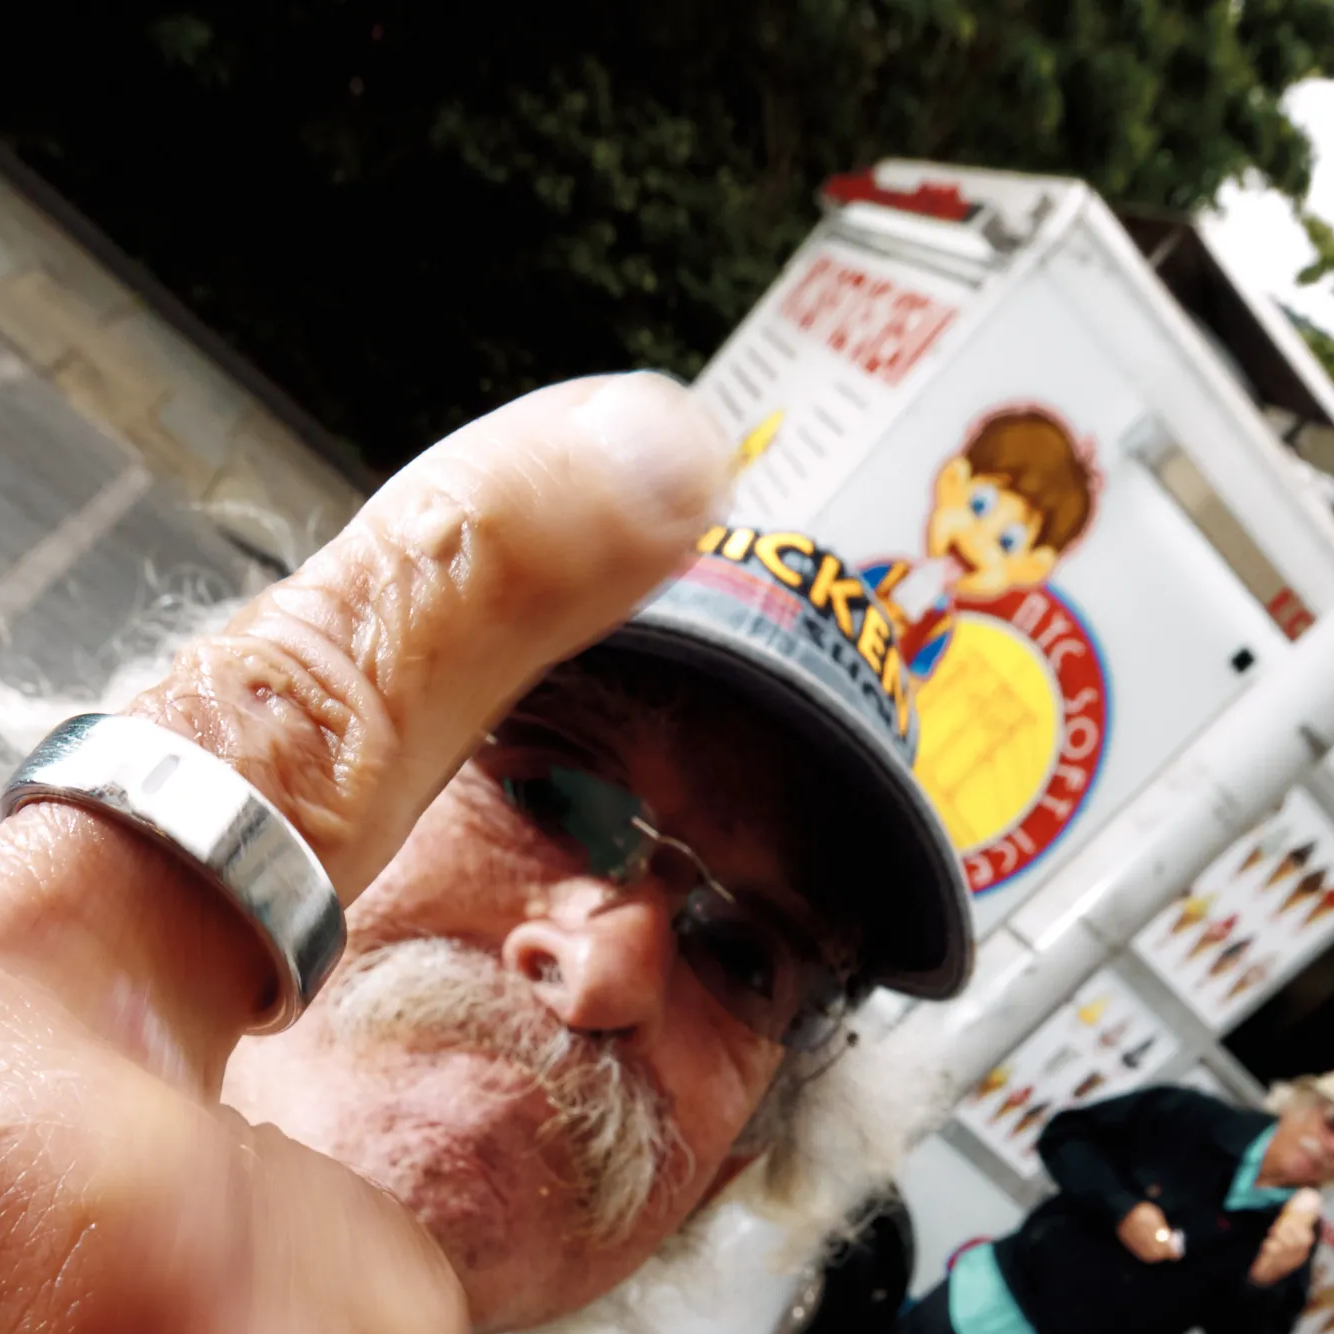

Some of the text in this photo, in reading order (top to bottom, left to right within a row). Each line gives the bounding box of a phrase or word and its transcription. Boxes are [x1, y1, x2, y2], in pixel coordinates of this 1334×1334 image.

[695, 524, 909, 740] ICKEN
[1011, 592, 1088, 676] NYC
[1039, 686, 1100, 822] SOFT
